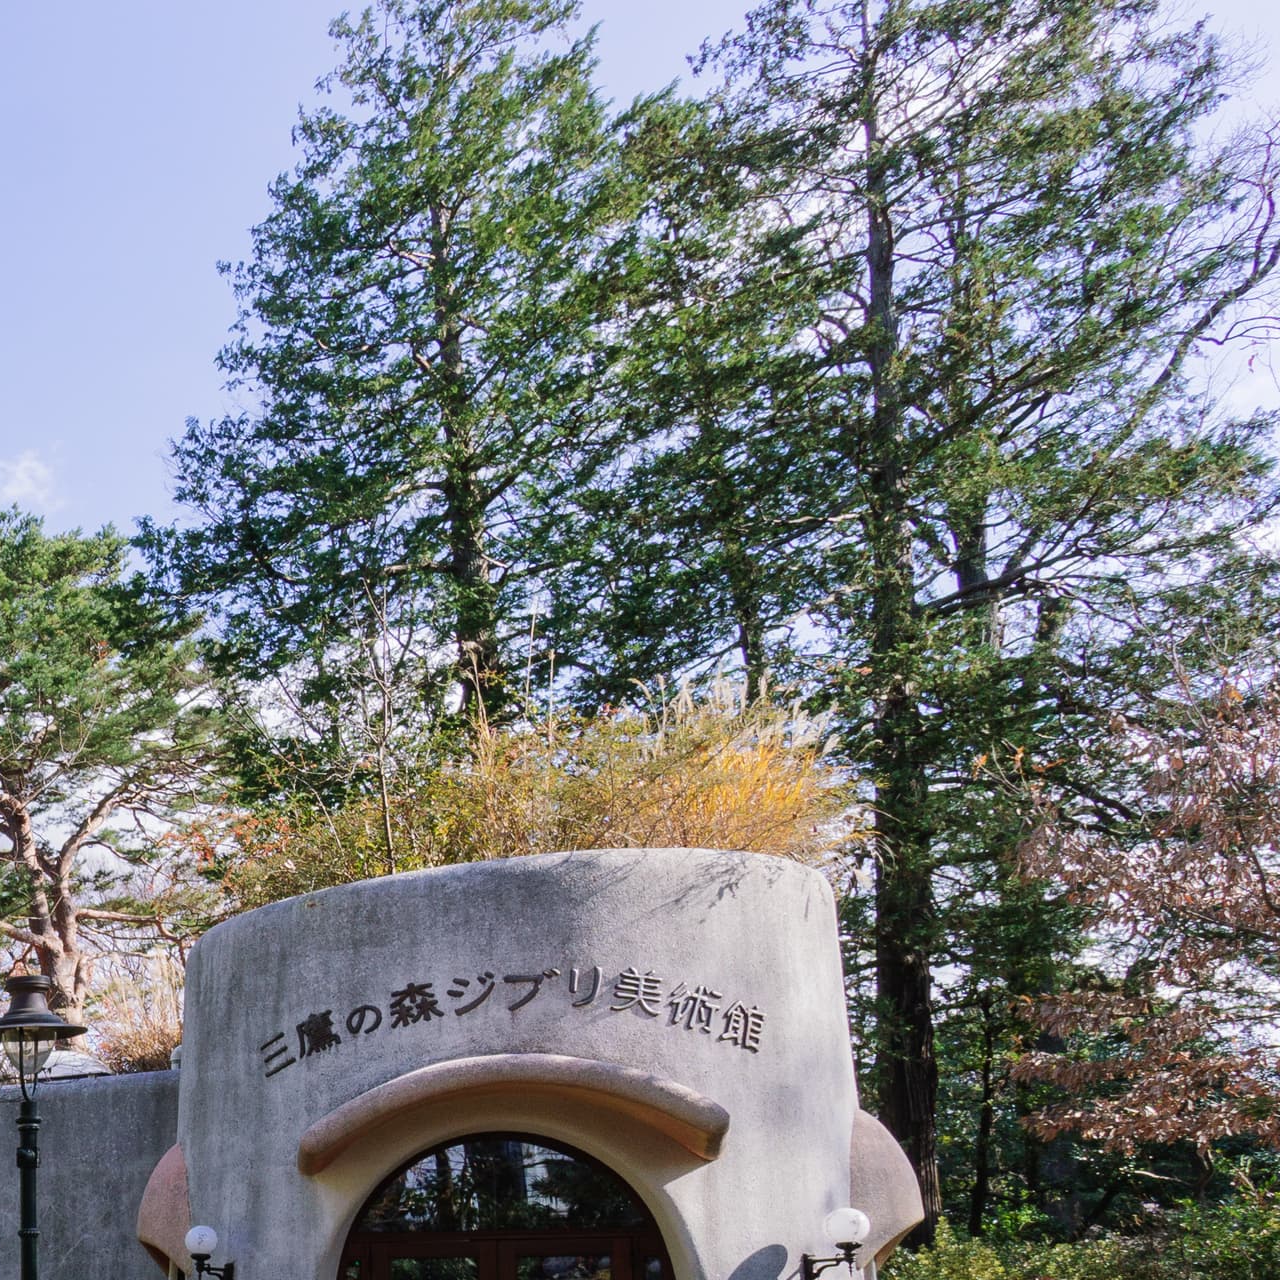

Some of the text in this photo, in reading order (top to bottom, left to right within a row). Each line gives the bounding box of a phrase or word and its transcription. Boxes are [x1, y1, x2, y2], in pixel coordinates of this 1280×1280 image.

[259, 965, 769, 1078] 三鷹の森ジブリ美術館
